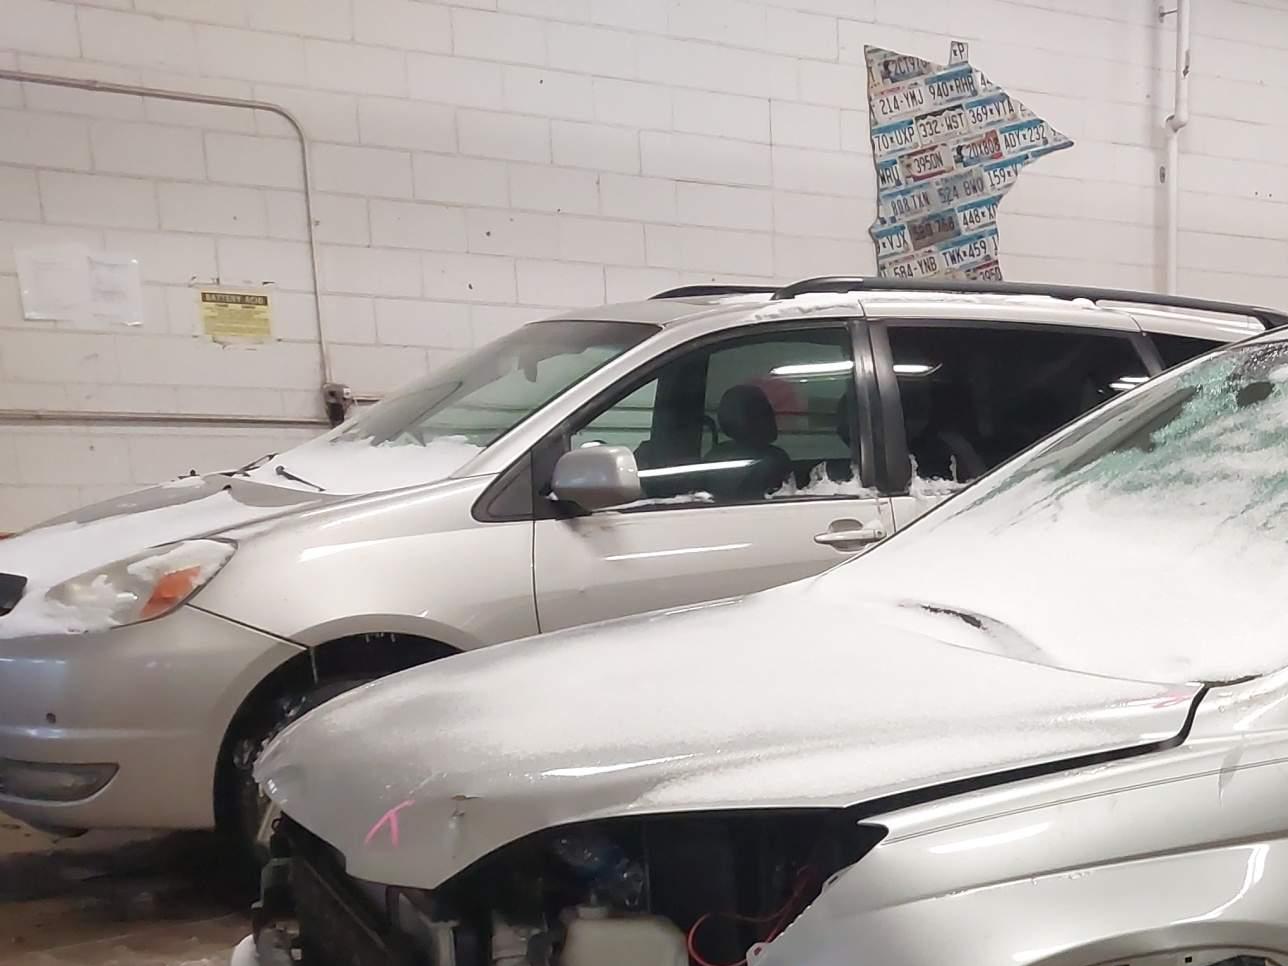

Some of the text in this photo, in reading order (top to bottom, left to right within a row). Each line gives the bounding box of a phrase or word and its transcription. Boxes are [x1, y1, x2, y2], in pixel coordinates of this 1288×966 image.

[929, 81, 949, 100] 940
[969, 106, 988, 124] 369
[894, 126, 915, 146] UXP
[987, 168, 1006, 187] 159
[962, 207, 981, 227] 448
